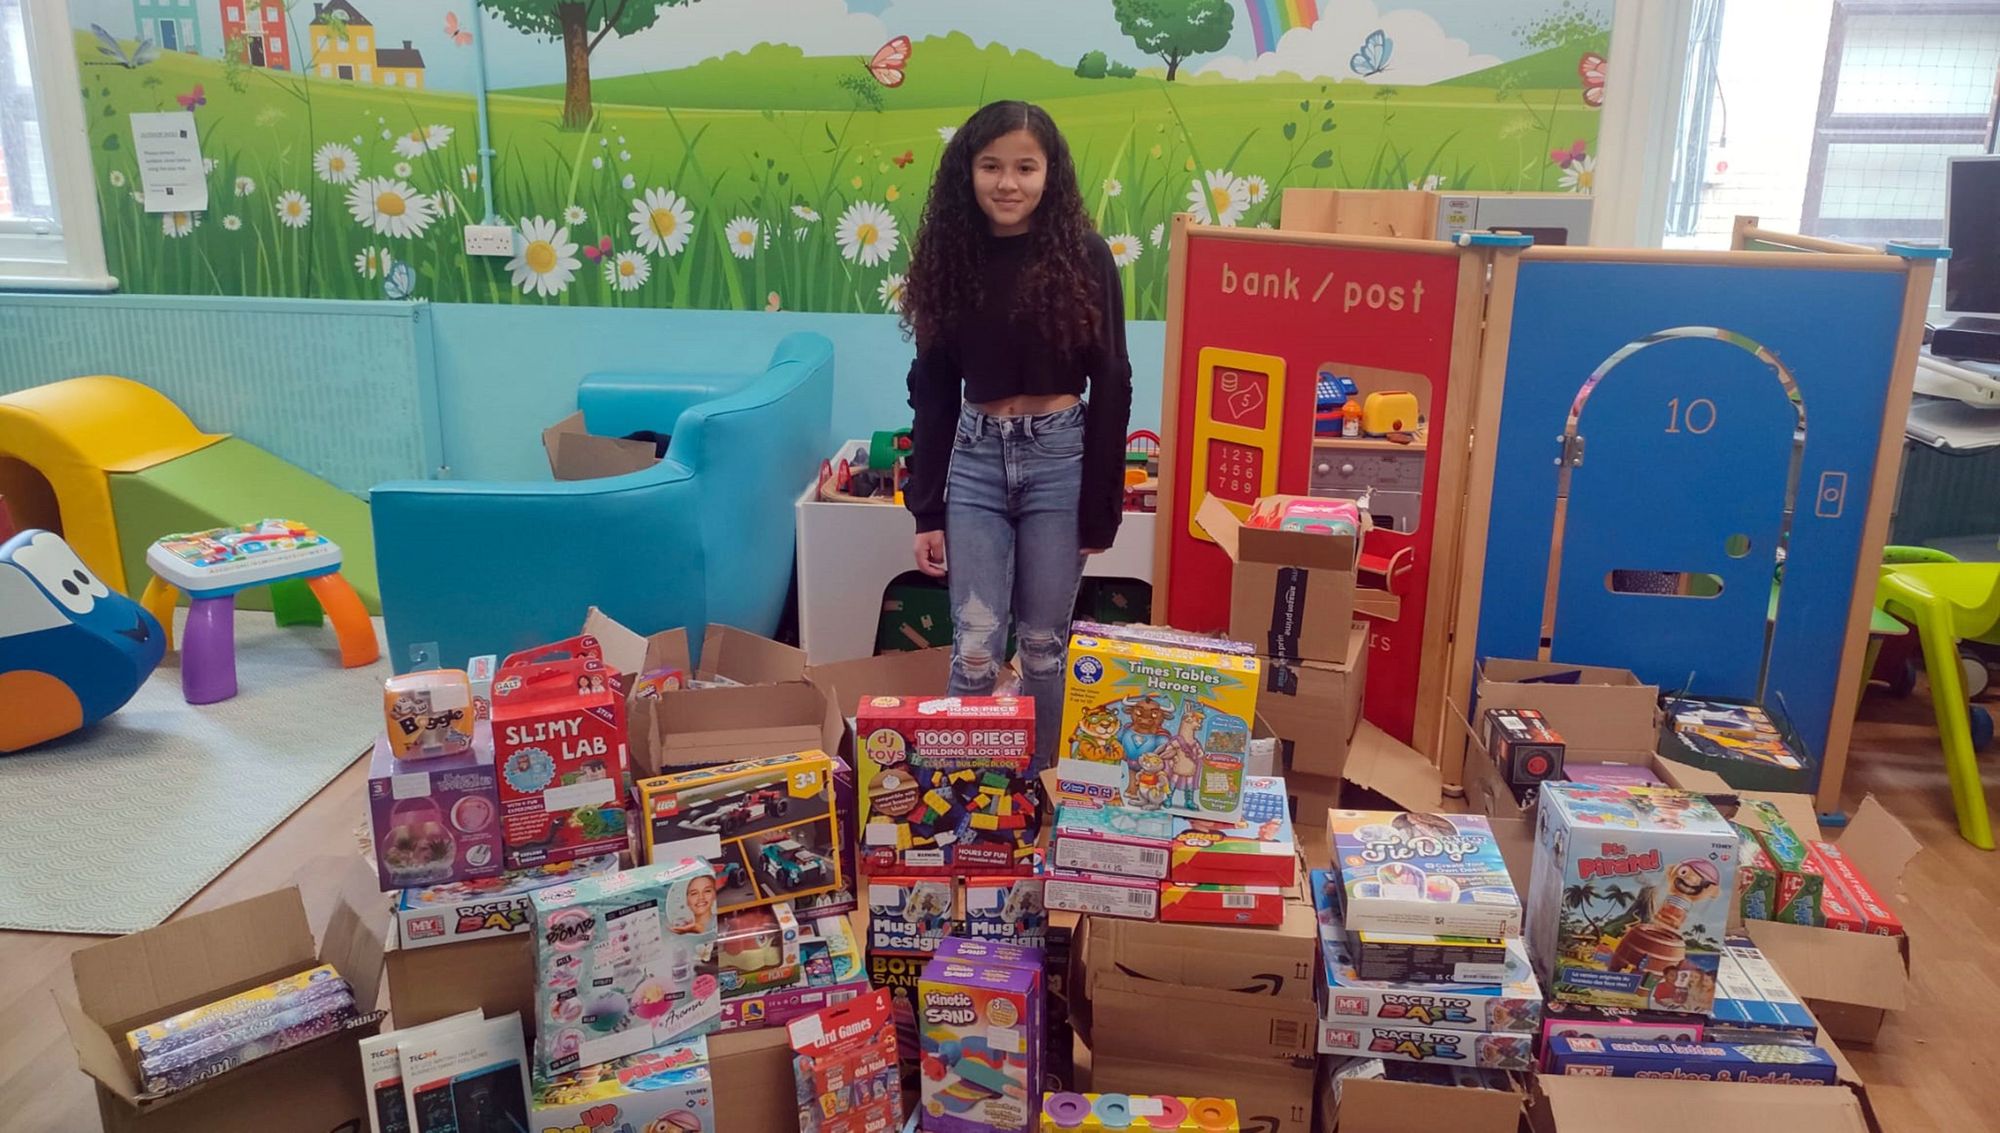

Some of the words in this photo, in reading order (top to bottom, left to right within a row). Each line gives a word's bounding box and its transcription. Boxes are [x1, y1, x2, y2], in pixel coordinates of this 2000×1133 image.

[1222, 262, 1300, 301] bank
[1344, 280, 1424, 313] post
[1665, 397, 1716, 434] 10
[1284, 612, 1296, 637] prime
[1128, 661, 1169, 677] Times
[1173, 668, 1221, 685] Tables
[1148, 677, 1197, 694] Heroes
[596, 708, 614, 720] STEM
[505, 717, 583, 745] SLIMY
[917, 731, 966, 746] 1000
[972, 731, 1025, 746] PIECE
[562, 737, 607, 760] LAB
[877, 732, 895, 748] dj
[868, 749, 906, 764] toys
[919, 748, 965, 756] BUILDING
[967, 748, 1000, 757] BLOCK
[1003, 748, 1023, 757] SET
[958, 848, 982, 856] HOURS
[993, 851, 1008, 859] FUN
[457, 900, 512, 917] RACE
[411, 920, 434, 932] MY
[455, 909, 530, 934] BAS
[874, 919, 917, 936] Mug
[971, 921, 1015, 938] Mug
[546, 918, 596, 945] BOMB
[873, 934, 943, 951] Design
[876, 995, 883, 1005] 4
[926, 994, 971, 1006] Kinetic
[1339, 1000, 1360, 1010] MY
[1383, 994, 1433, 1005] RACE
[1440, 997, 1471, 1008] TO
[1378, 1003, 1476, 1025] BASE
[838, 1018, 872, 1038] Games
[1373, 1029, 1425, 1041] RACE
[1431, 1033, 1461, 1044] TO
[1329, 1033, 1351, 1043] MY
[1368, 1038, 1467, 1060] BASE
[580, 1104, 618, 1129] UP
